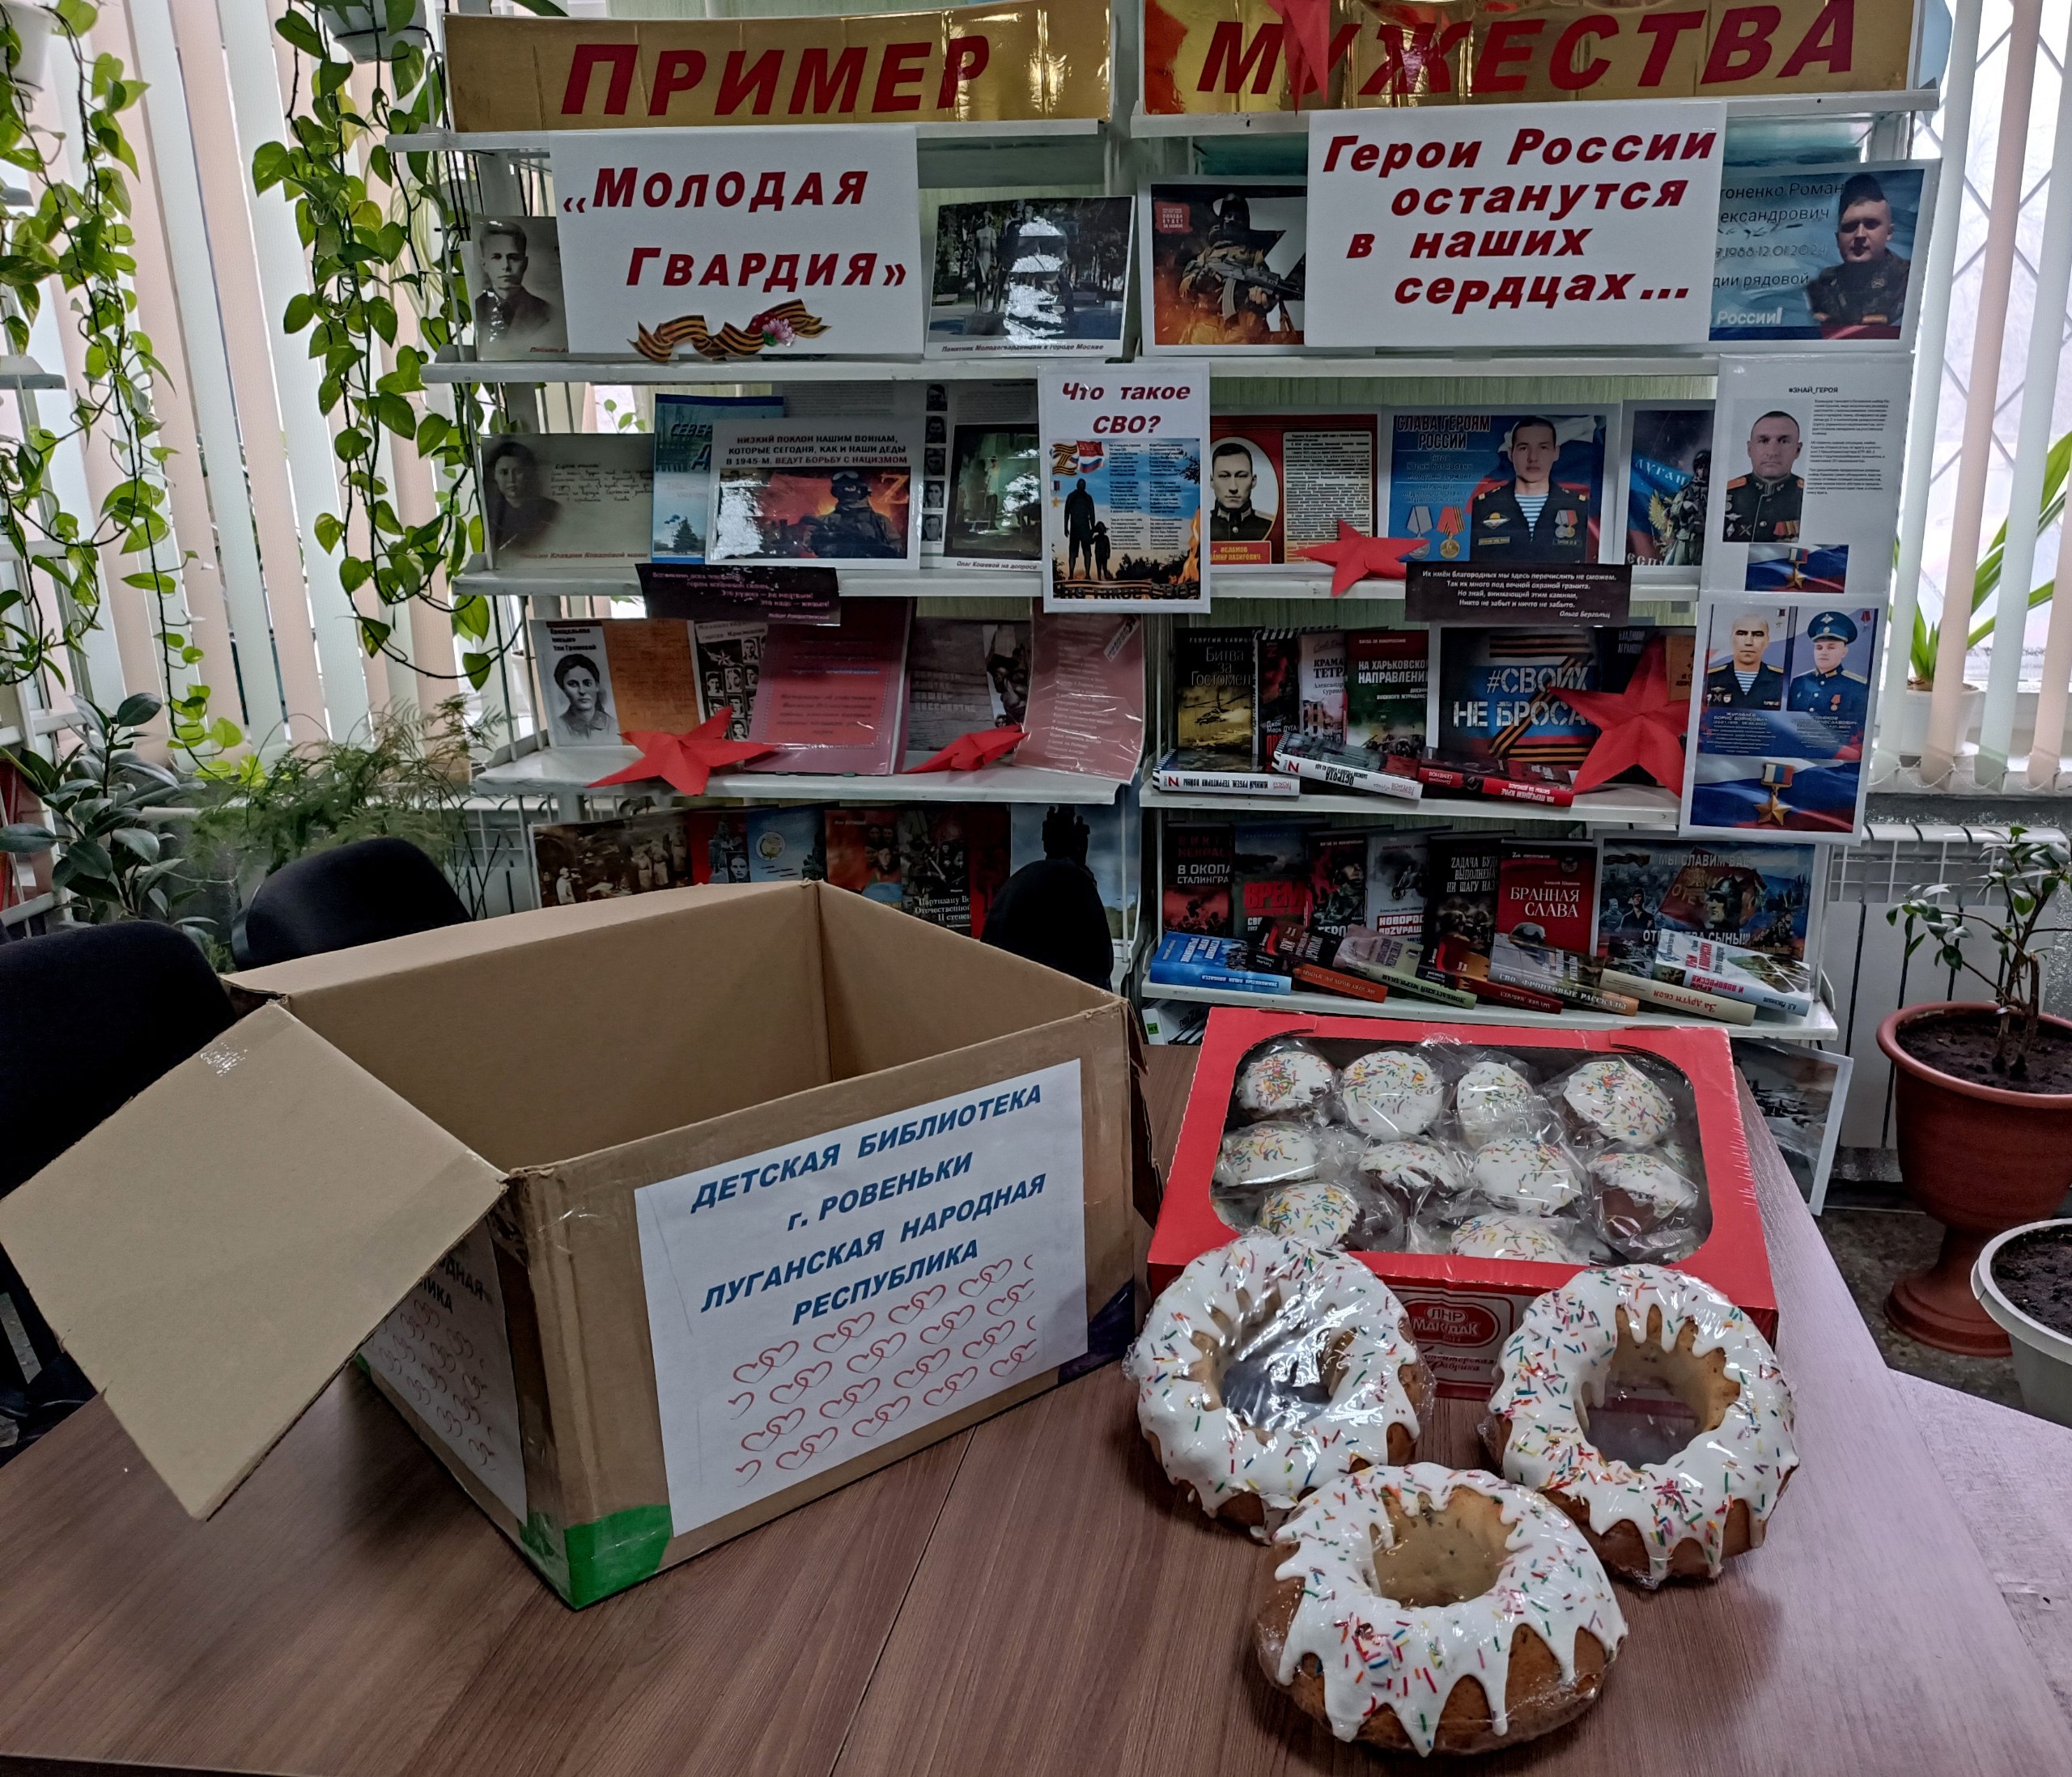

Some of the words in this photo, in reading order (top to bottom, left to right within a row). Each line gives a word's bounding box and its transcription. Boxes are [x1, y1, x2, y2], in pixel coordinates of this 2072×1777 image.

[561, 35, 991, 117] ПРИМЕР
[1323, 133, 1481, 175] Герои
[1507, 125, 1717, 168] России
[1390, 178, 1688, 219] останутся
[1347, 231, 1373, 261] в
[1409, 227, 1586, 261] наших
[1743, 272, 1809, 288] рядовой
[1394, 273, 1690, 314] сердцах...
[1062, 382, 1105, 402] Что
[1119, 384, 1191, 401] такое
[1092, 414, 1161, 435] СВО?
[1395, 415, 1440, 432] СЛАВА
[1441, 414, 1491, 432] ГЕРОЯМ
[737, 434, 775, 444] НИЗКИЙ
[777, 435, 813, 444] ПОКЛОН
[816, 435, 852, 443] НАШИМ
[855, 435, 898, 444] ВОИНАМ,
[1417, 432, 1468, 451] РОССИИ
[728, 446, 771, 455] КОТОРЫЕ
[773, 446, 817, 455] СЕГОДНЯ,
[879, 445, 906, 454] ДЕДЫ
[726, 457, 732, 465] В
[775, 456, 804, 465] ВЕДУТ
[805, 456, 841, 464] БОРЬБУ
[852, 456, 907, 464] НАЦИЗМОМ
[1452, 570, 1497, 579] благородных
[1531, 573, 1575, 581] перечислить
[1487, 591, 1530, 599] внимающий
[1205, 647, 1244, 663] Битва
[1217, 663, 1232, 673] за
[1358, 660, 1370, 671] НА
[1486, 667, 1589, 693] #СВОИХ
[1453, 701, 1488, 727] НЕ
[1496, 701, 1593, 727] БРОСА
[1324, 771, 1355, 786] ОСТРОТА
[1501, 788, 1516, 797] КРАЕ
[1516, 791, 1546, 802] ПЕРЕДНЕМ
[1681, 854, 1726, 867] СЛАВИМ
[1178, 864, 1187, 875] В
[1446, 881, 1457, 892] НИ
[1459, 881, 1480, 893] ШАГУ
[1510, 886, 1580, 902] БРАННАЯ
[1524, 901, 1579, 918] СЛАВА
[1580, 992, 1628, 1011] РАССКАЗЫ
[1704, 1003, 1717, 1014] За
[690, 1143, 841, 1214] ДЕТСКАЯ
[857, 1084, 1042, 1159] БИБЛИОТЕКА
[788, 1211, 809, 1232] г.
[819, 1151, 973, 1223] РОВЕНЬКИ
[701, 1229, 885, 1313] ЛУГАНСКАЯ
[900, 1173, 1047, 1244] НАРОДНАЯ
[792, 1239, 979, 1325] РЕСПУБЛИКА
